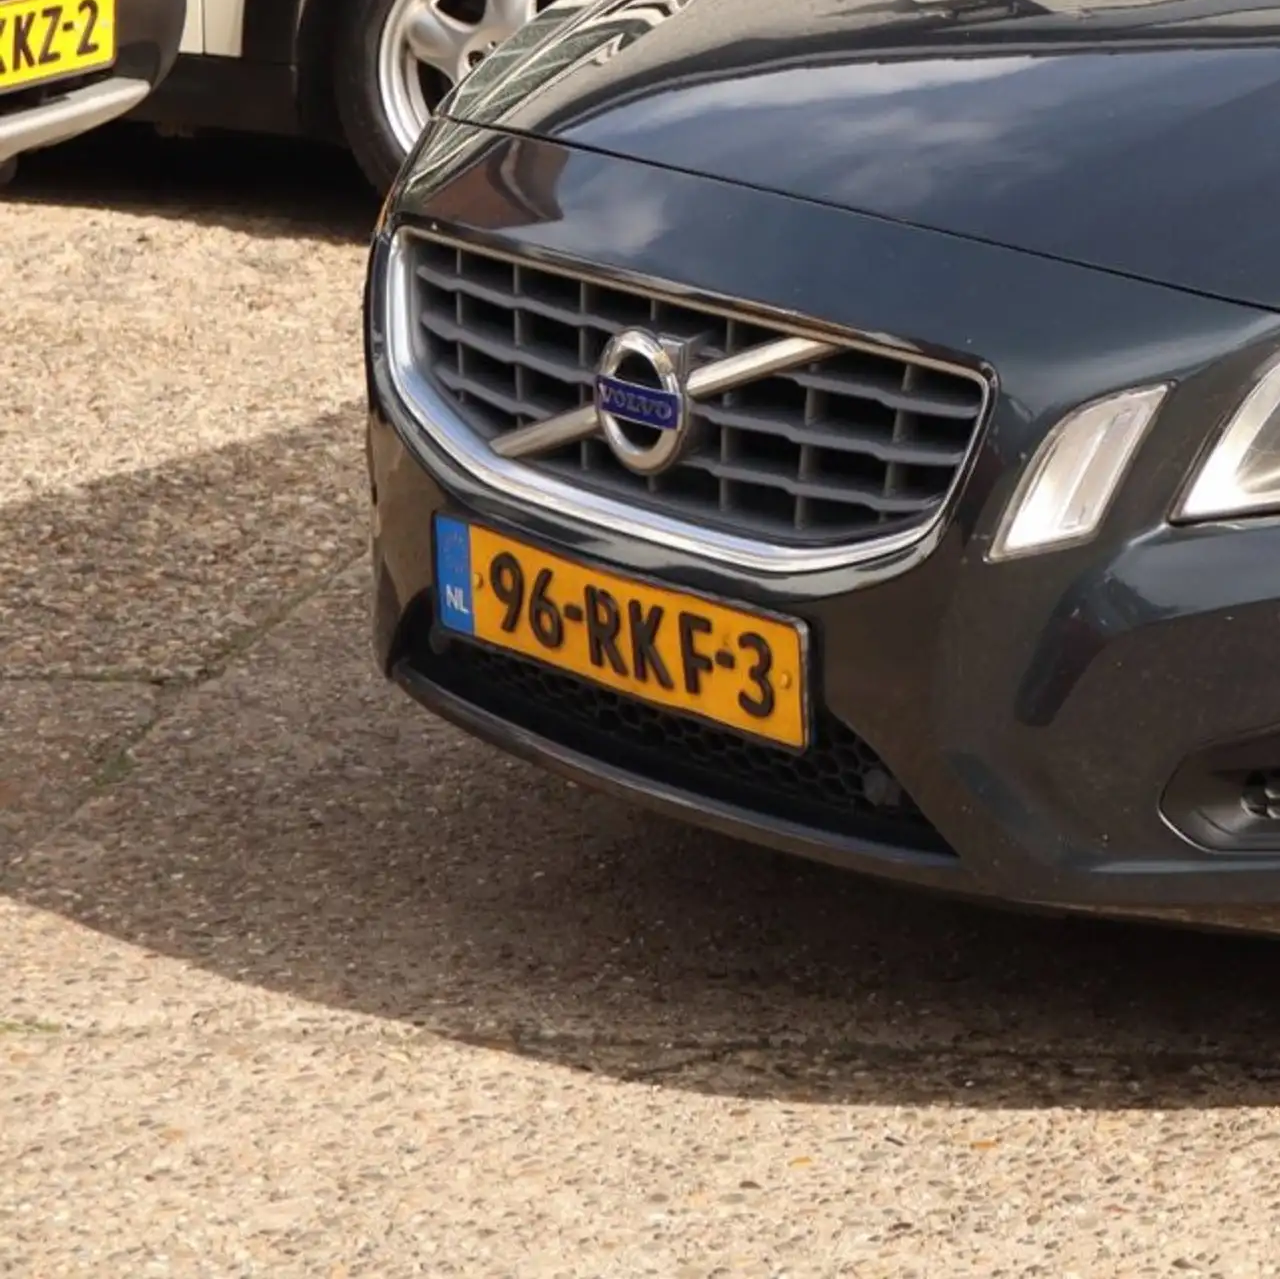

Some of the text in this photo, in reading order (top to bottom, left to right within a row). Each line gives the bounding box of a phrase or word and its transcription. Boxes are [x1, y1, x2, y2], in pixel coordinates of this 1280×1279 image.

[598, 381, 673, 420] VOLVO
[445, 584, 470, 615] NL
[487, 551, 776, 719] 96-RKF-3
